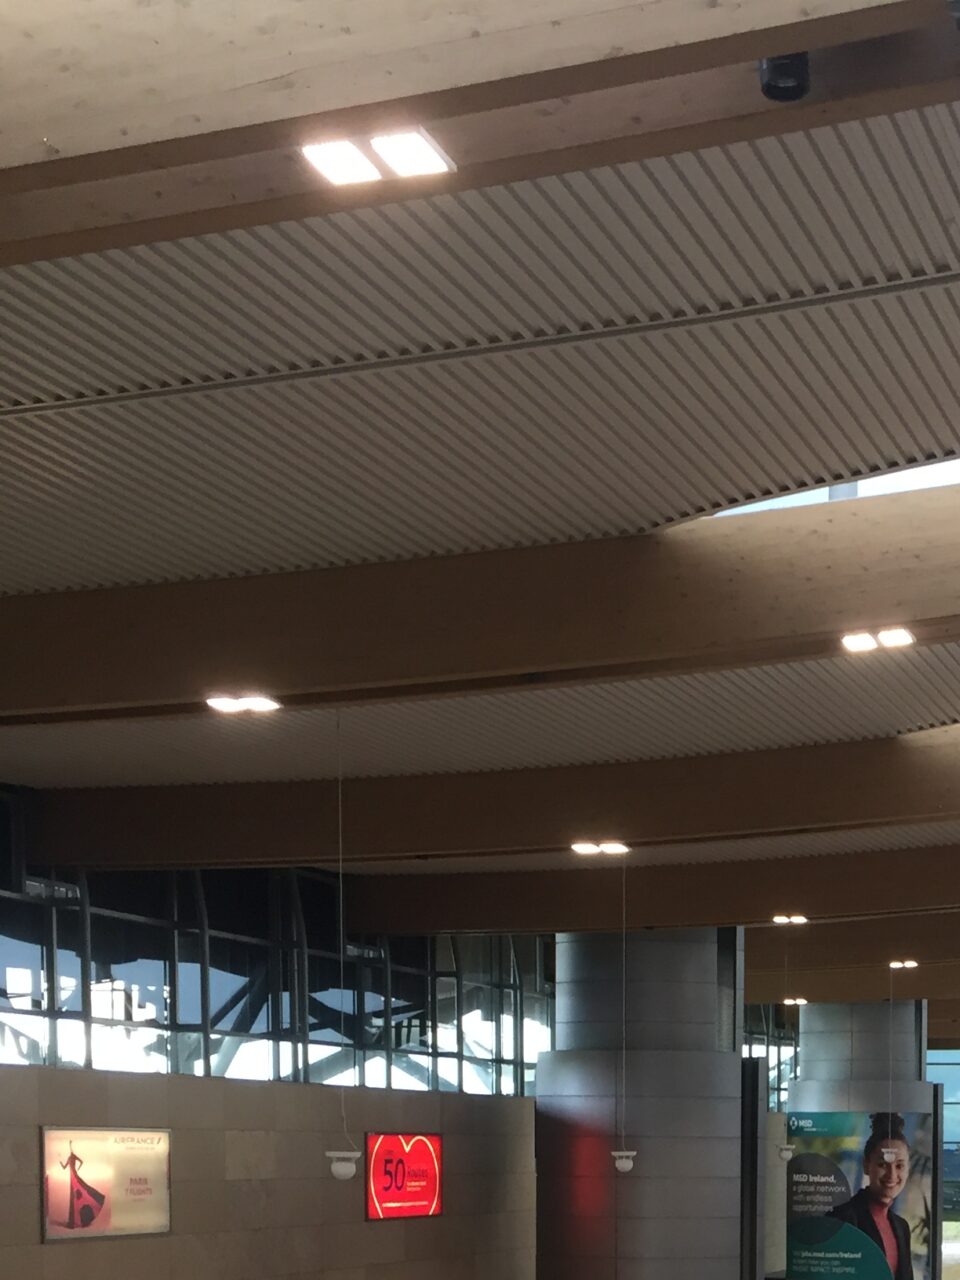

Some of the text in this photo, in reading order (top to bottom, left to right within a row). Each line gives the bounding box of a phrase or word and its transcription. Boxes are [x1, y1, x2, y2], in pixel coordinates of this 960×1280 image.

[799, 1119, 813, 1127] MSD
[383, 1158, 406, 1191] 50
[793, 1174, 808, 1182] MSD
